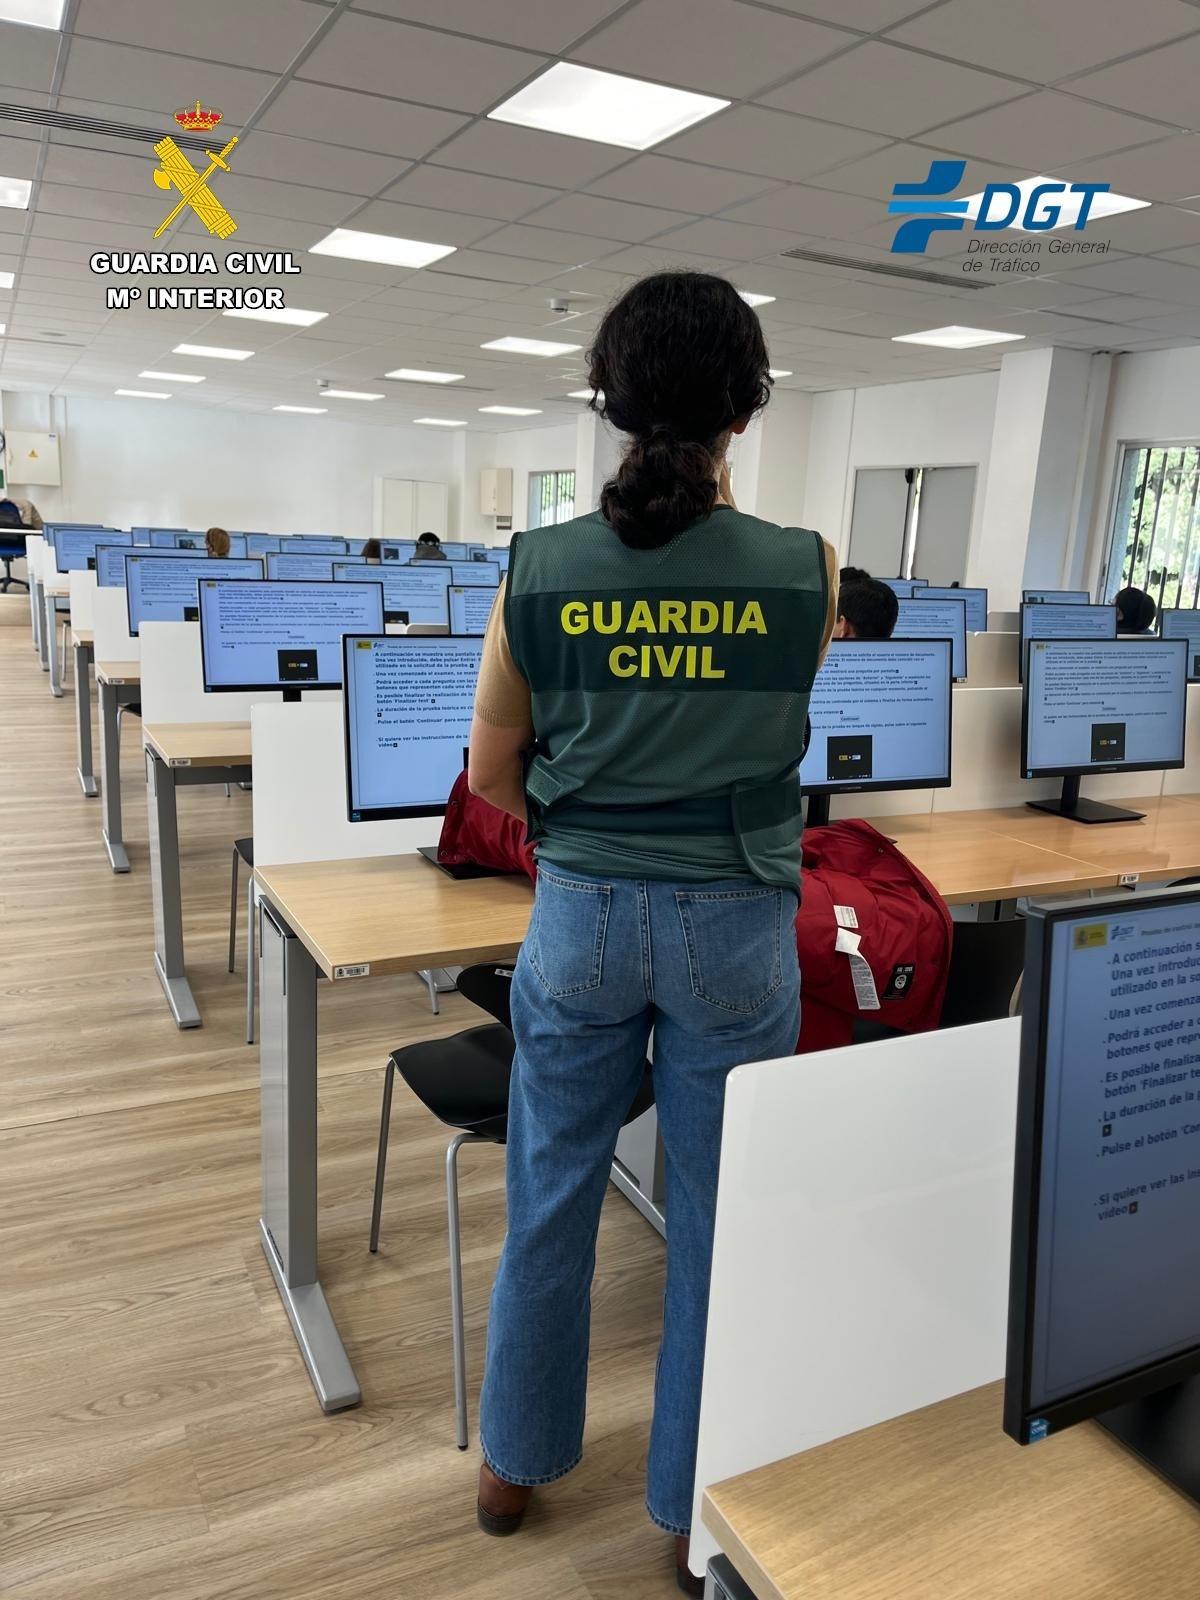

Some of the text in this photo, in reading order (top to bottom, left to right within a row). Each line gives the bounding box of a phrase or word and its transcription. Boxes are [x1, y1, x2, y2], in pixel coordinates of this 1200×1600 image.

[560, 600, 768, 635] GUARDIA
[608, 645, 726, 678] CIVIL
[1112, 952, 1120, 965] A
[1123, 941, 1192, 963] continuación
[1112, 968, 1133, 980] Una
[1136, 965, 1155, 976] vez
[1110, 978, 1158, 997] utilizado
[1161, 976, 1174, 988] en
[1176, 974, 1186, 985] la
[1108, 1008, 1130, 1020] Una
[1134, 1004, 1152, 1015] vez
[1108, 1026, 1140, 1044] Podrá
[1143, 1020, 1185, 1036] acceder
[1188, 1018, 1194, 1027] a
[1106, 1042, 1151, 1060] botones
[1154, 1038, 1174, 1052] que
[1105, 1072, 1118, 1083] Es
[1121, 1062, 1160, 1082] posible
[1104, 1082, 1136, 1099] botón
[1104, 1110, 1116, 1122] La
[1119, 1098, 1166, 1118] duración
[1169, 1094, 1182, 1105] de
[1184, 1091, 1194, 1102] la
[1102, 1141, 1132, 1157] Pulse
[1134, 1135, 1144, 1148] el
[1147, 1128, 1178, 1145] botón
[1099, 1192, 1110, 1206] Si
[1112, 1184, 1147, 1203] quiere
[1150, 1179, 1167, 1191] ver
[1170, 1173, 1185, 1185] las
